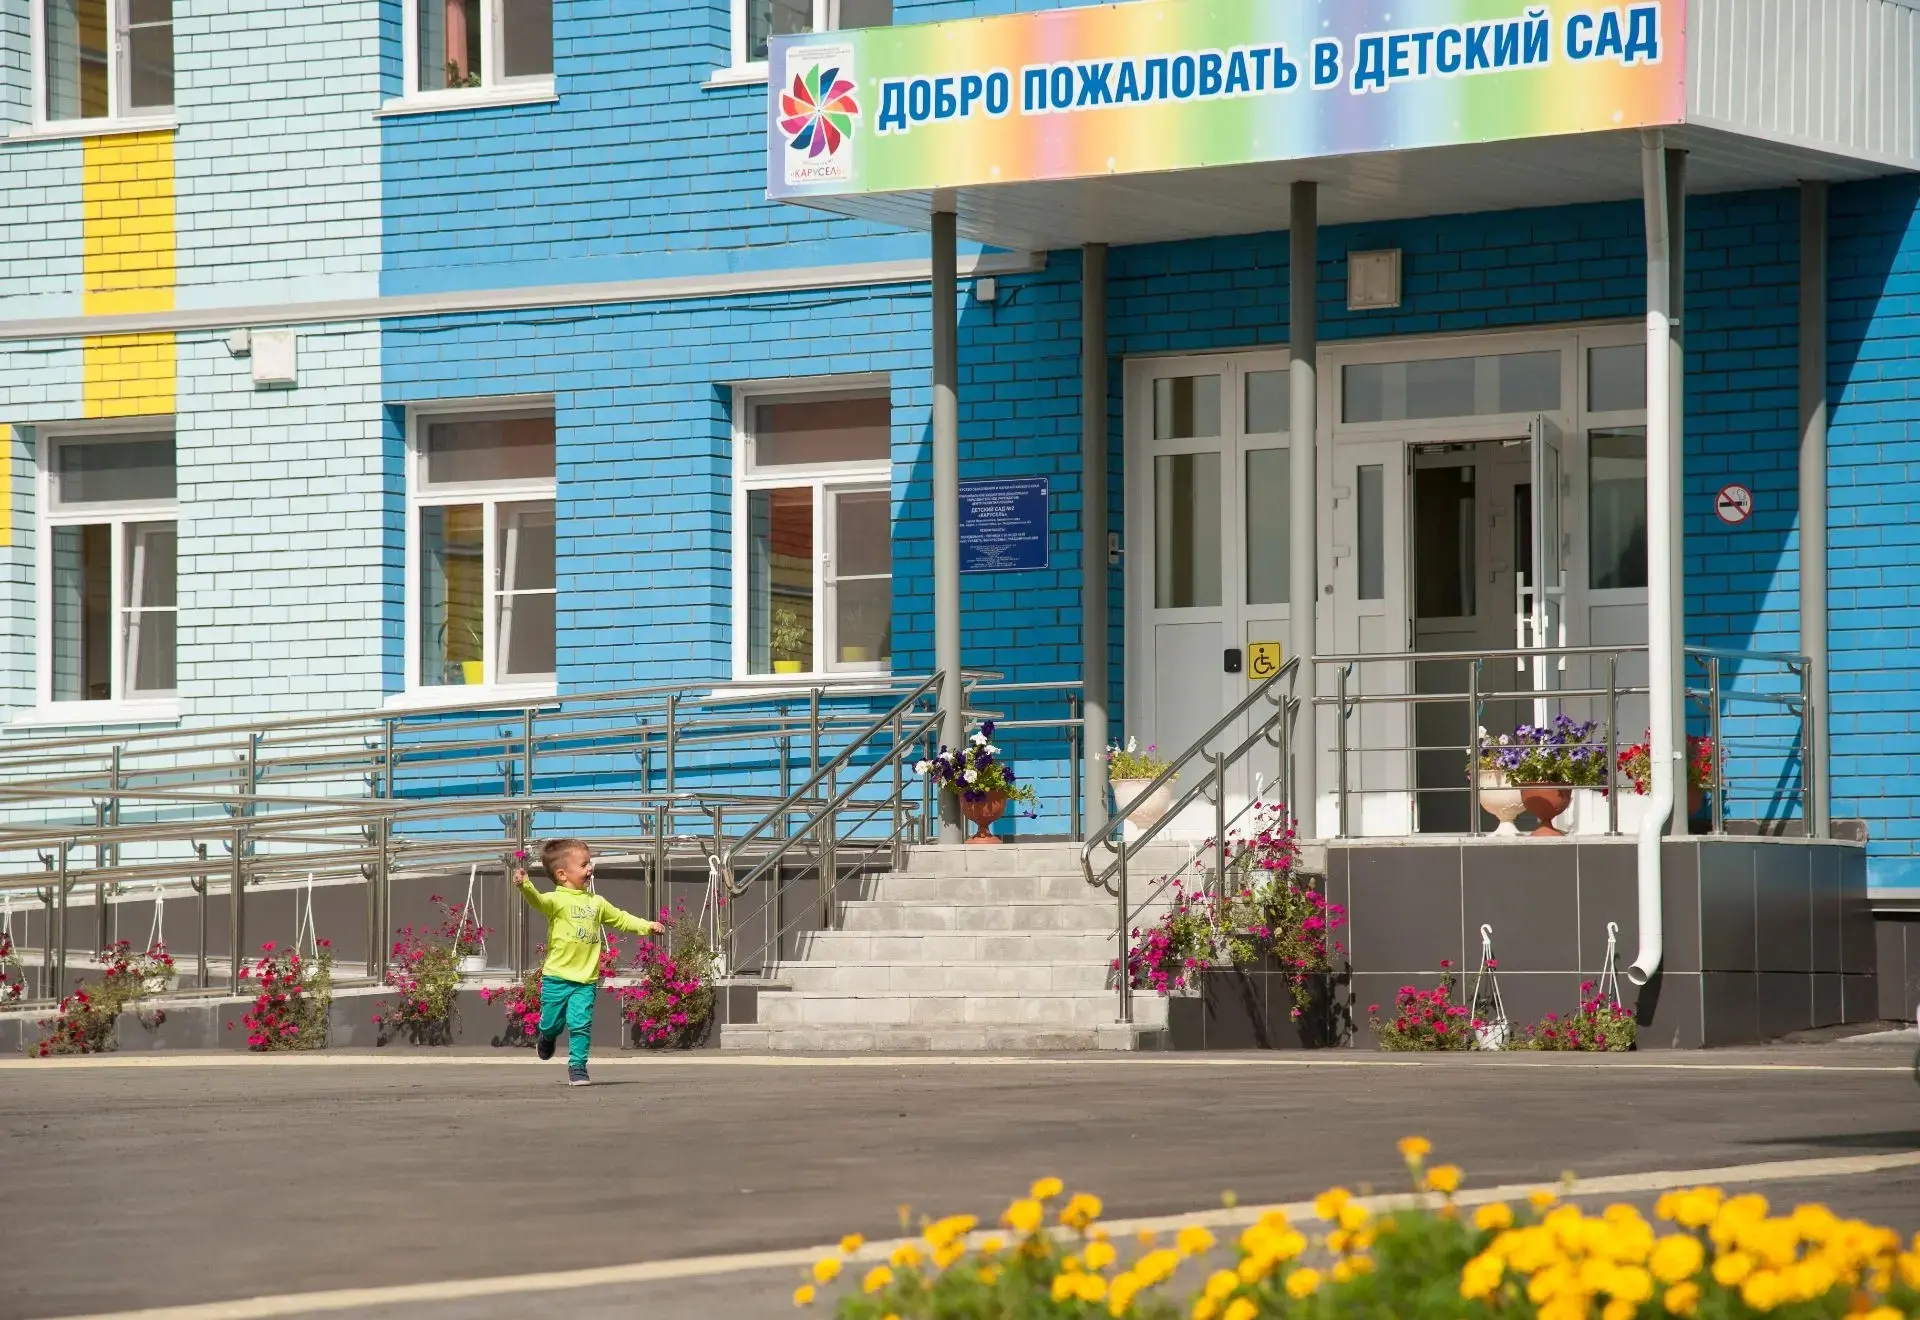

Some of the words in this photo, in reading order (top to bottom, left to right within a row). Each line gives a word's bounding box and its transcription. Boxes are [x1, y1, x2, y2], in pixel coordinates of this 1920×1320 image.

[878, 72, 1009, 131] ДОБРО
[1024, 47, 1297, 111] ПОЖАЛОВАТЬ
[1314, 42, 1339, 85] В
[1354, 9, 1549, 90] ДЕТСКИЙ
[1566, 7, 1658, 62] САД
